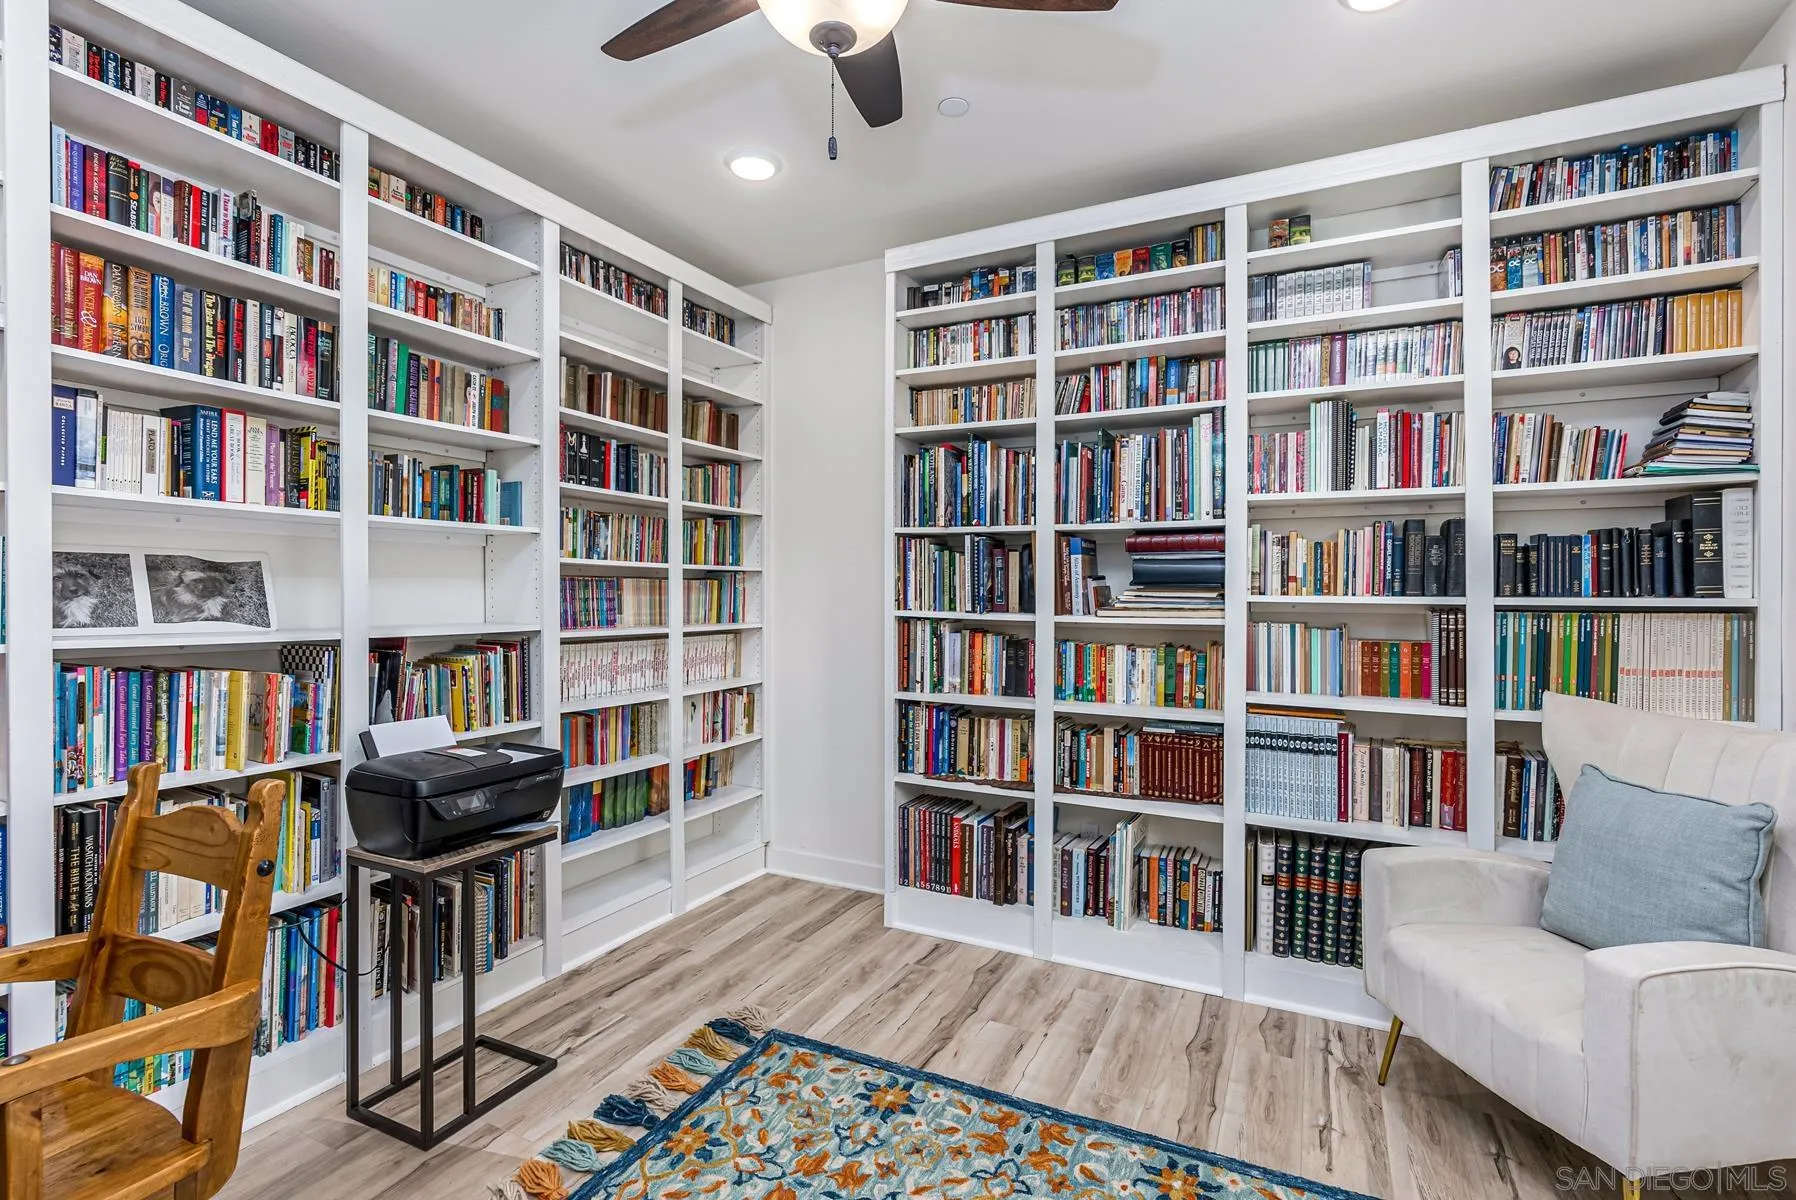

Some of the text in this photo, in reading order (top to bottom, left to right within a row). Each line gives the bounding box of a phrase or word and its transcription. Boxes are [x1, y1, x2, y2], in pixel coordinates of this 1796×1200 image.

[1508, 259, 1521, 267] OC
[1524, 257, 1537, 265] OC
[112, 264, 121, 284] DAN
[204, 294, 216, 307] The
[159, 301, 170, 336] BROWN
[148, 430, 156, 452] PLATO
[210, 420, 219, 485] LEND ME YOUR EARS
[1120, 480, 1128, 504] Games
[1074, 557, 1082, 568] Atlas
[1074, 576, 1082, 599] Anatomy
[119, 686, 128, 764] Great Illustrated Fairy Tales
[131, 683, 139, 761] Great Illustrated Fairy Tales
[145, 685, 154, 761] Great Illustrated Fairy Tales
[1358, 769, 1367, 787] Smith
[953, 821, 961, 849] ANIMALS
[69, 847, 80, 867] THE
[69, 867, 80, 893] BIBLE
[84, 835, 94, 908] WASATCH MOUNTAINS
[1196, 868, 1206, 914] GRIZZLY COUNTRY
